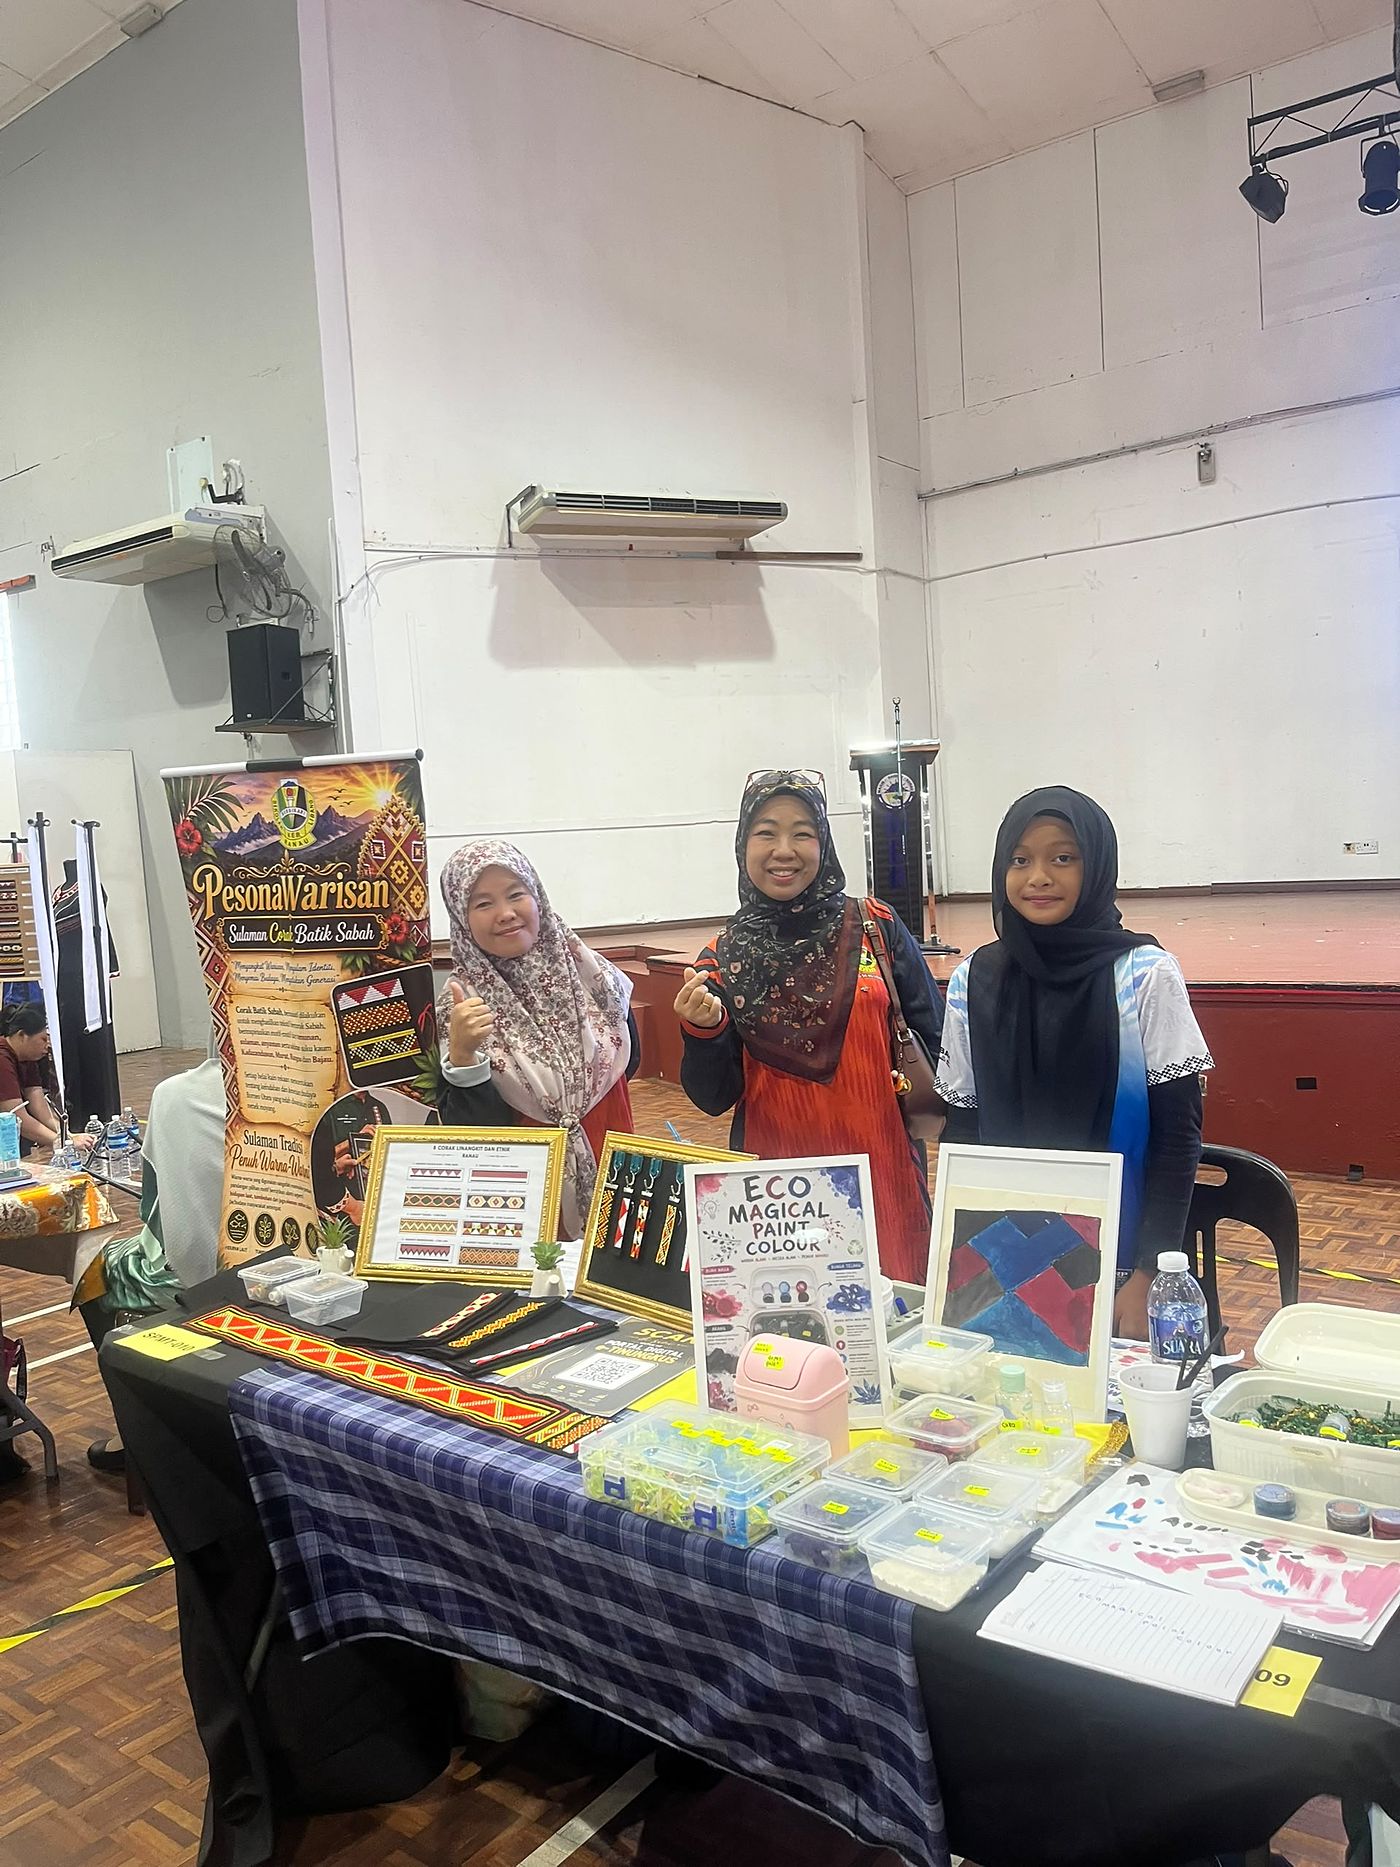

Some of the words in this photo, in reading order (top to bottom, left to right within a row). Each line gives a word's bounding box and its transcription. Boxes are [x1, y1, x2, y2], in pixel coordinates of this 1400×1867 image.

[192, 863, 391, 920] PesonaWarisan
[229, 923, 268, 944] Sulaman
[294, 923, 333, 945] Batik
[335, 921, 375, 942] Sabah
[243, 1129, 279, 1149] Sulaman
[279, 1134, 304, 1154] Tradisi
[229, 1143, 258, 1170] Penuh
[259, 1149, 311, 1179] Warna-Warni
[742, 1174, 812, 1203] ECO
[728, 1201, 830, 1225] MAGICAL
[752, 1220, 810, 1239] PAINT
[746, 1239, 821, 1256] COLOUR
[633, 1328, 695, 1345] SCAN
[604, 1339, 642, 1351] PORTAL
[643, 1346, 684, 1359] DIGITAL
[1254, 1669, 1291, 1687] 09
